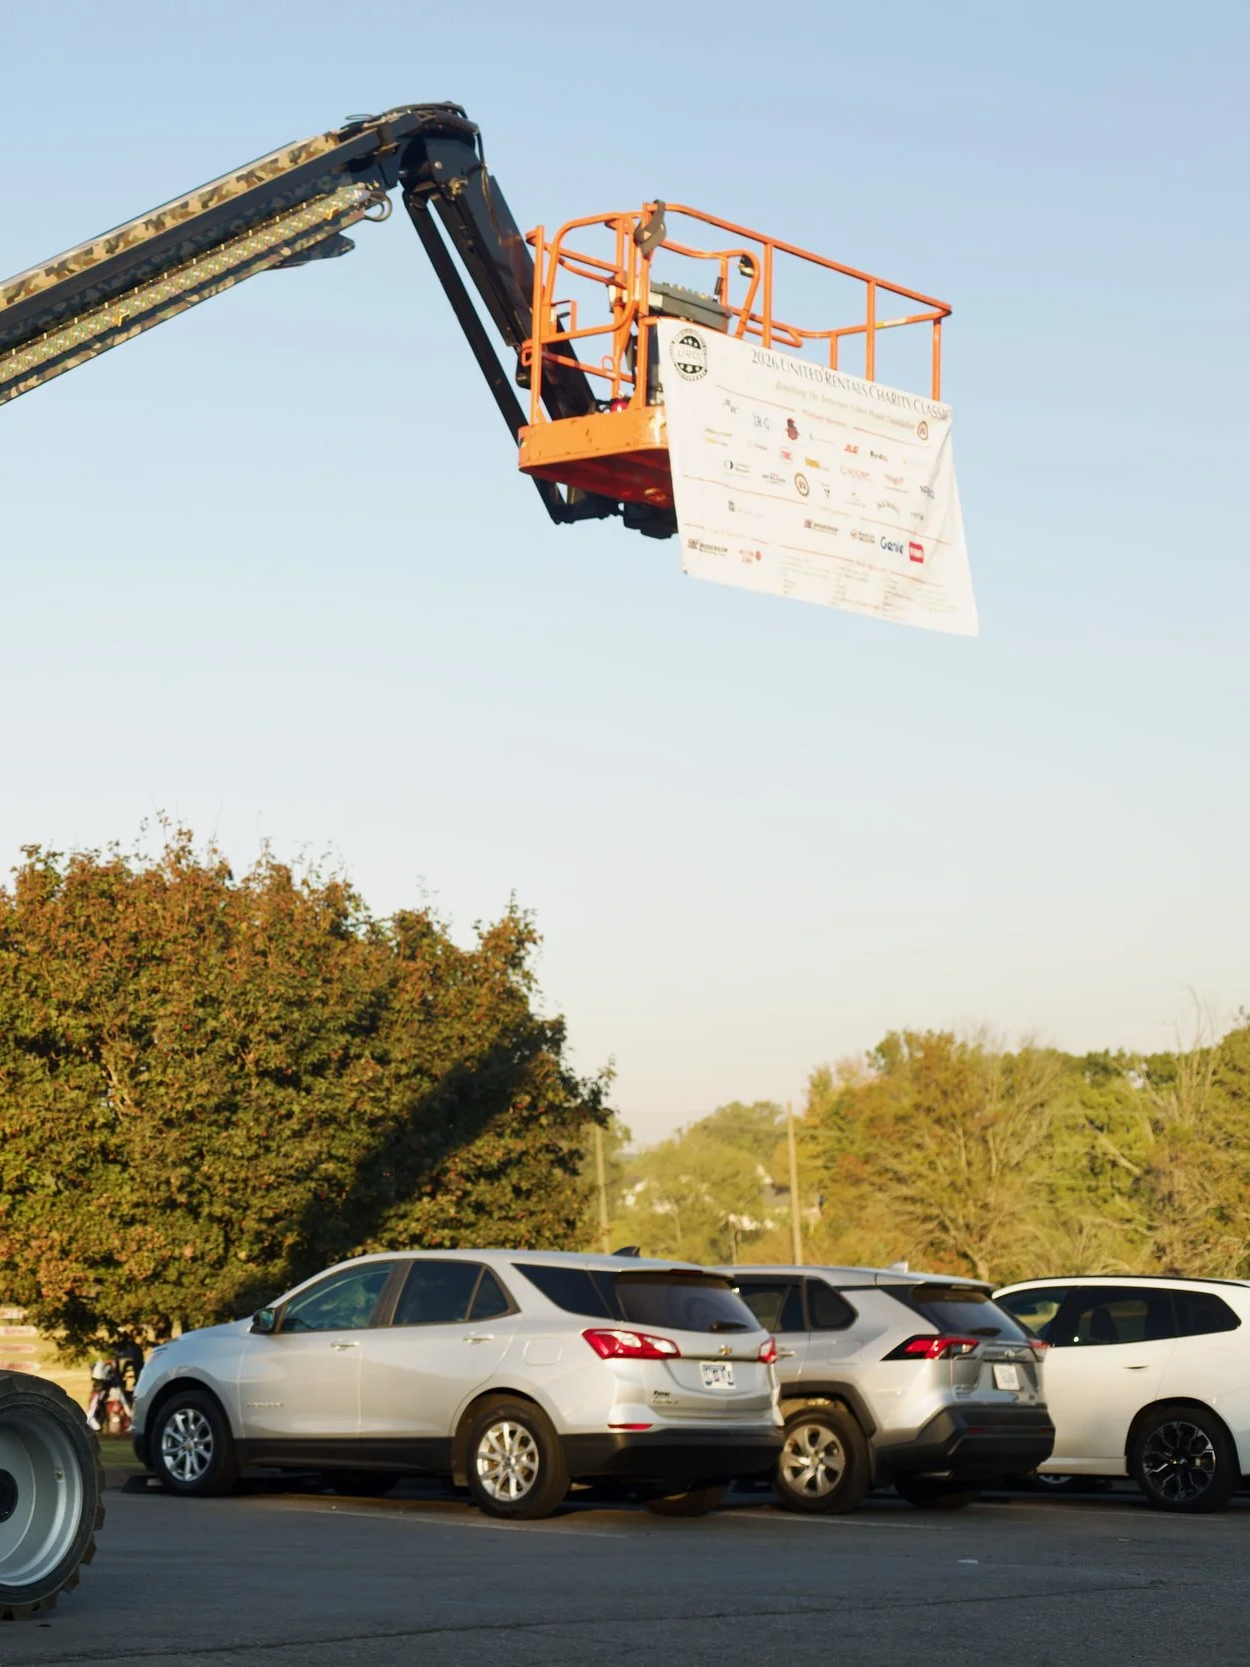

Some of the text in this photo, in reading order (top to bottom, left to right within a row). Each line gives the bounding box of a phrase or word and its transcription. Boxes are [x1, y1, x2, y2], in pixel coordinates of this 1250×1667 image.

[752, 348, 952, 422] 2026 UNITED RENTALS CHARITY CLASSIC
[880, 536, 904, 555] Genie
